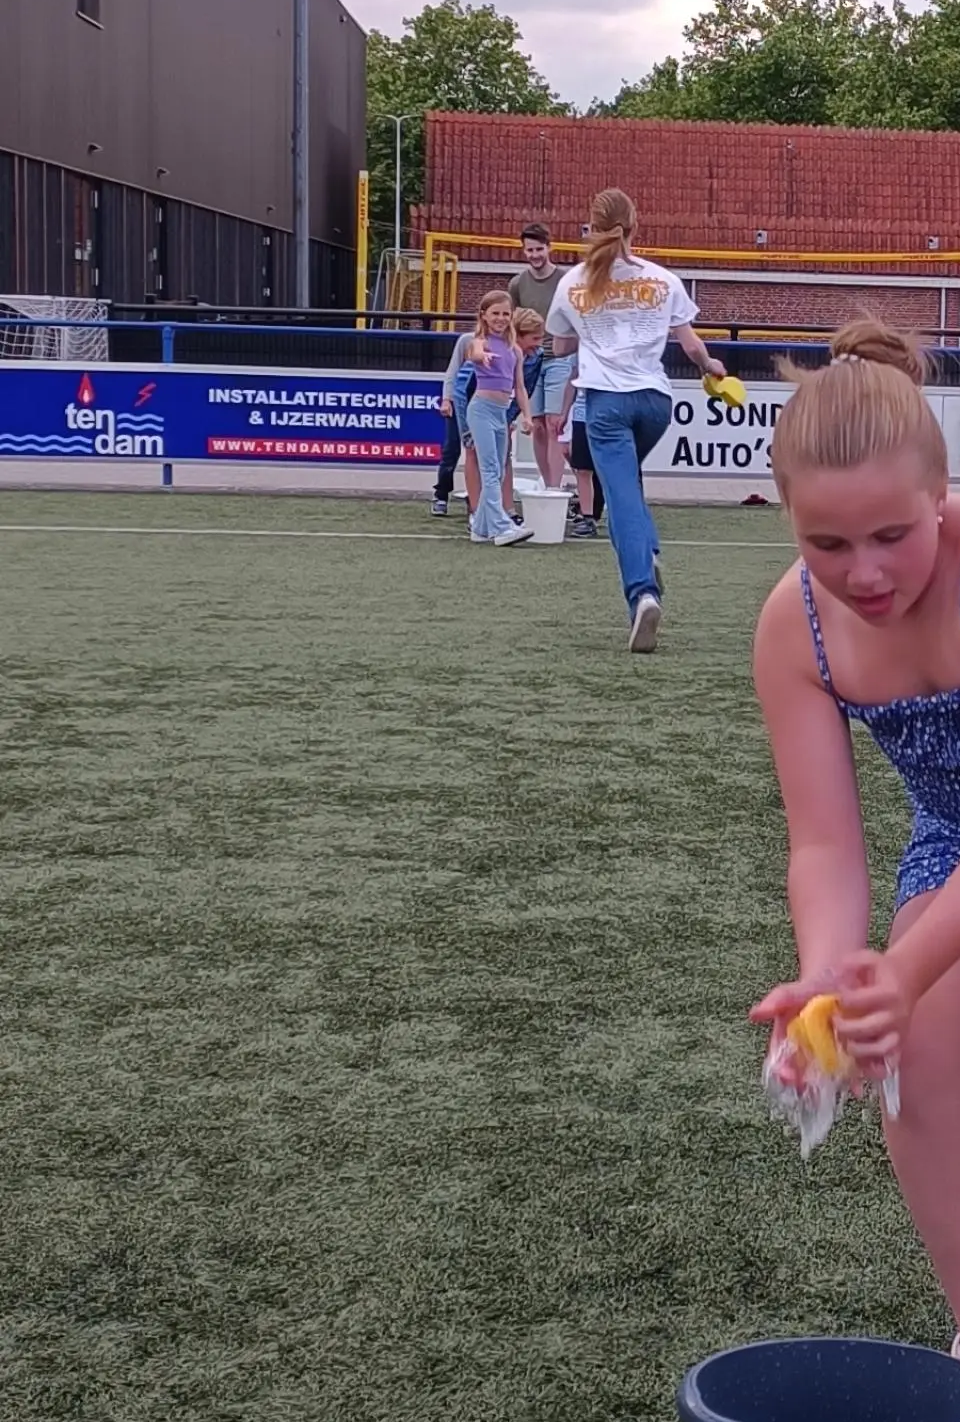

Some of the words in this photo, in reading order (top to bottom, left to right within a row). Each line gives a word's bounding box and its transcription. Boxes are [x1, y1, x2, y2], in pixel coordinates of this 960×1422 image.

[208, 388, 440, 409] INSTALLATIETECHNIEK
[65, 403, 114, 431] ten
[249, 410, 264, 425] &
[270, 411, 400, 429] IJZERWAREN
[95, 434, 163, 455] dam
[212, 440, 435, 457] WWW.TENDAMDELDEN.NL
